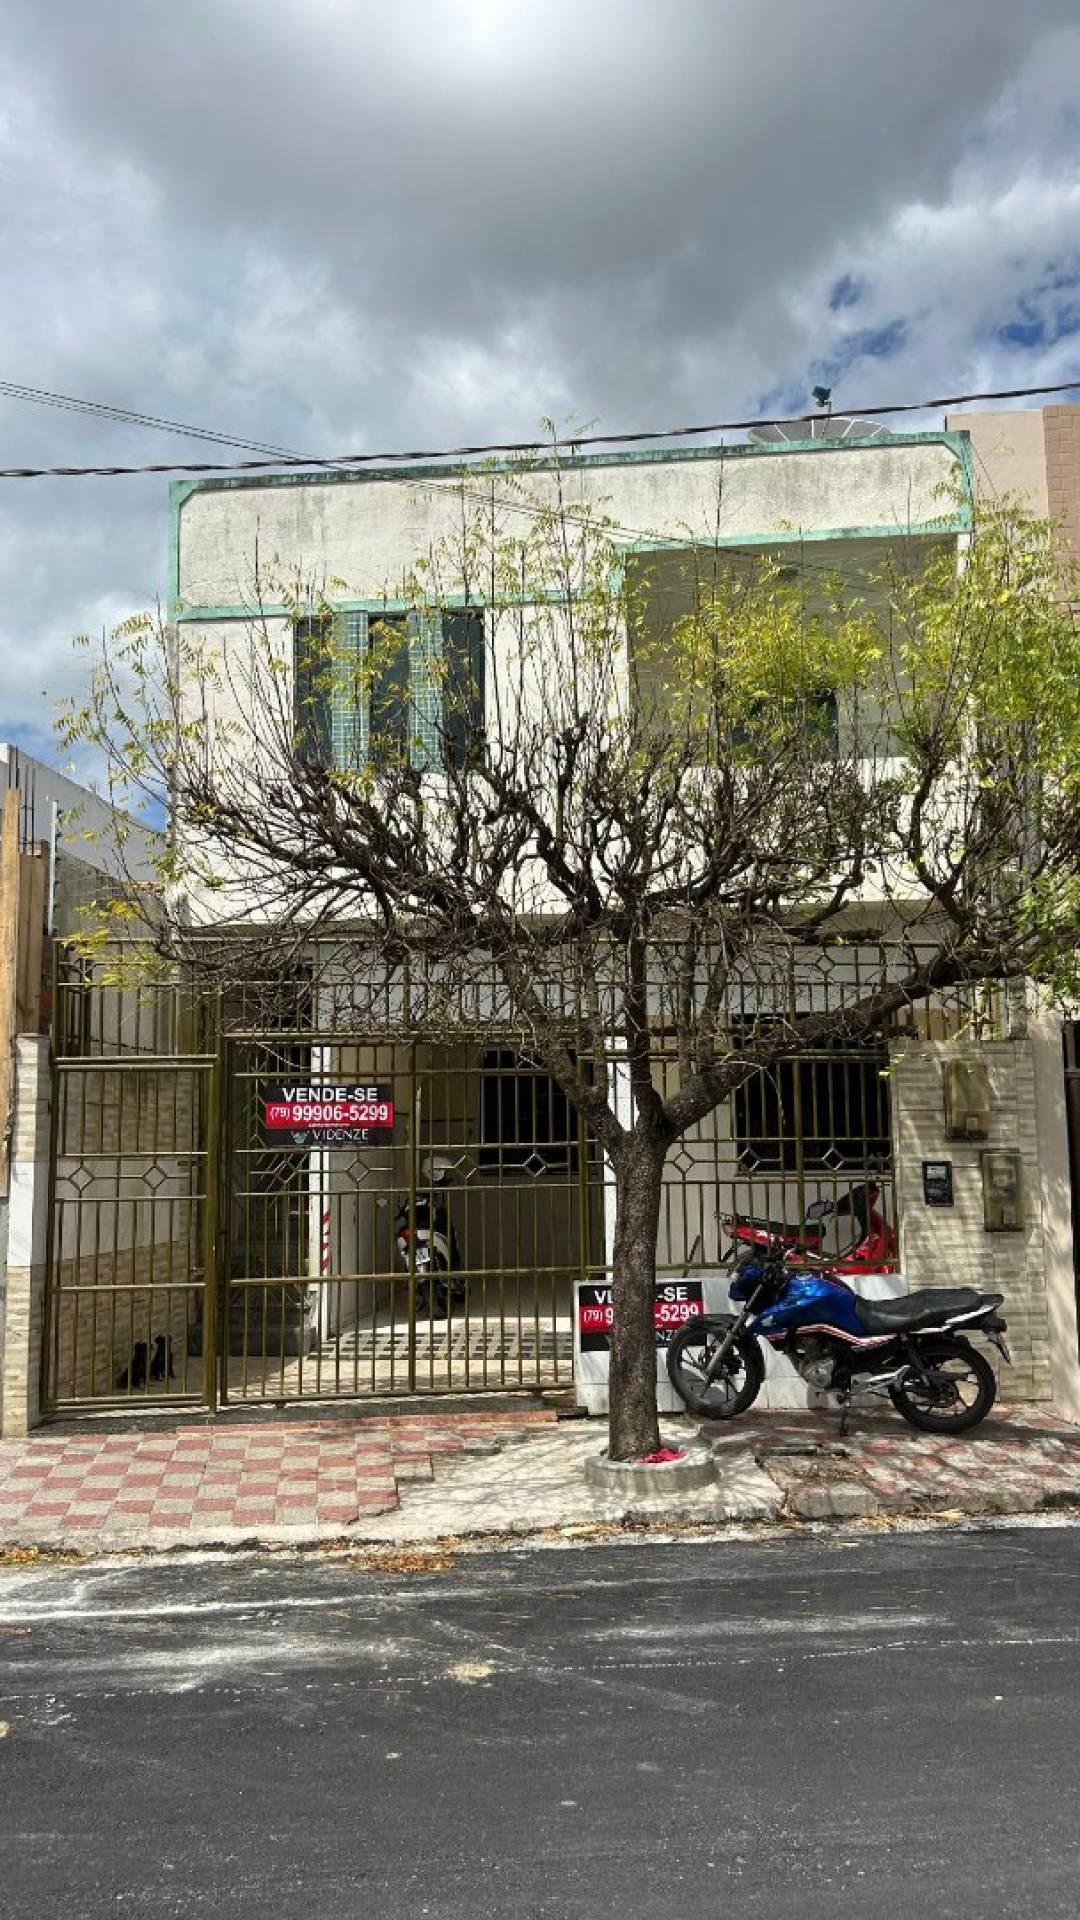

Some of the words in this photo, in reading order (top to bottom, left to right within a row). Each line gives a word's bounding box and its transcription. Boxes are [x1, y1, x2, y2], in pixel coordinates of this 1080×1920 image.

[282, 1087, 378, 1102] VENDE-SE
[270, 1106, 291, 1120] (79)
[292, 1105, 388, 1121] 99906-5299
[584, 1309, 603, 1323] (79)
[606, 1303, 698, 1325] 9-5299
